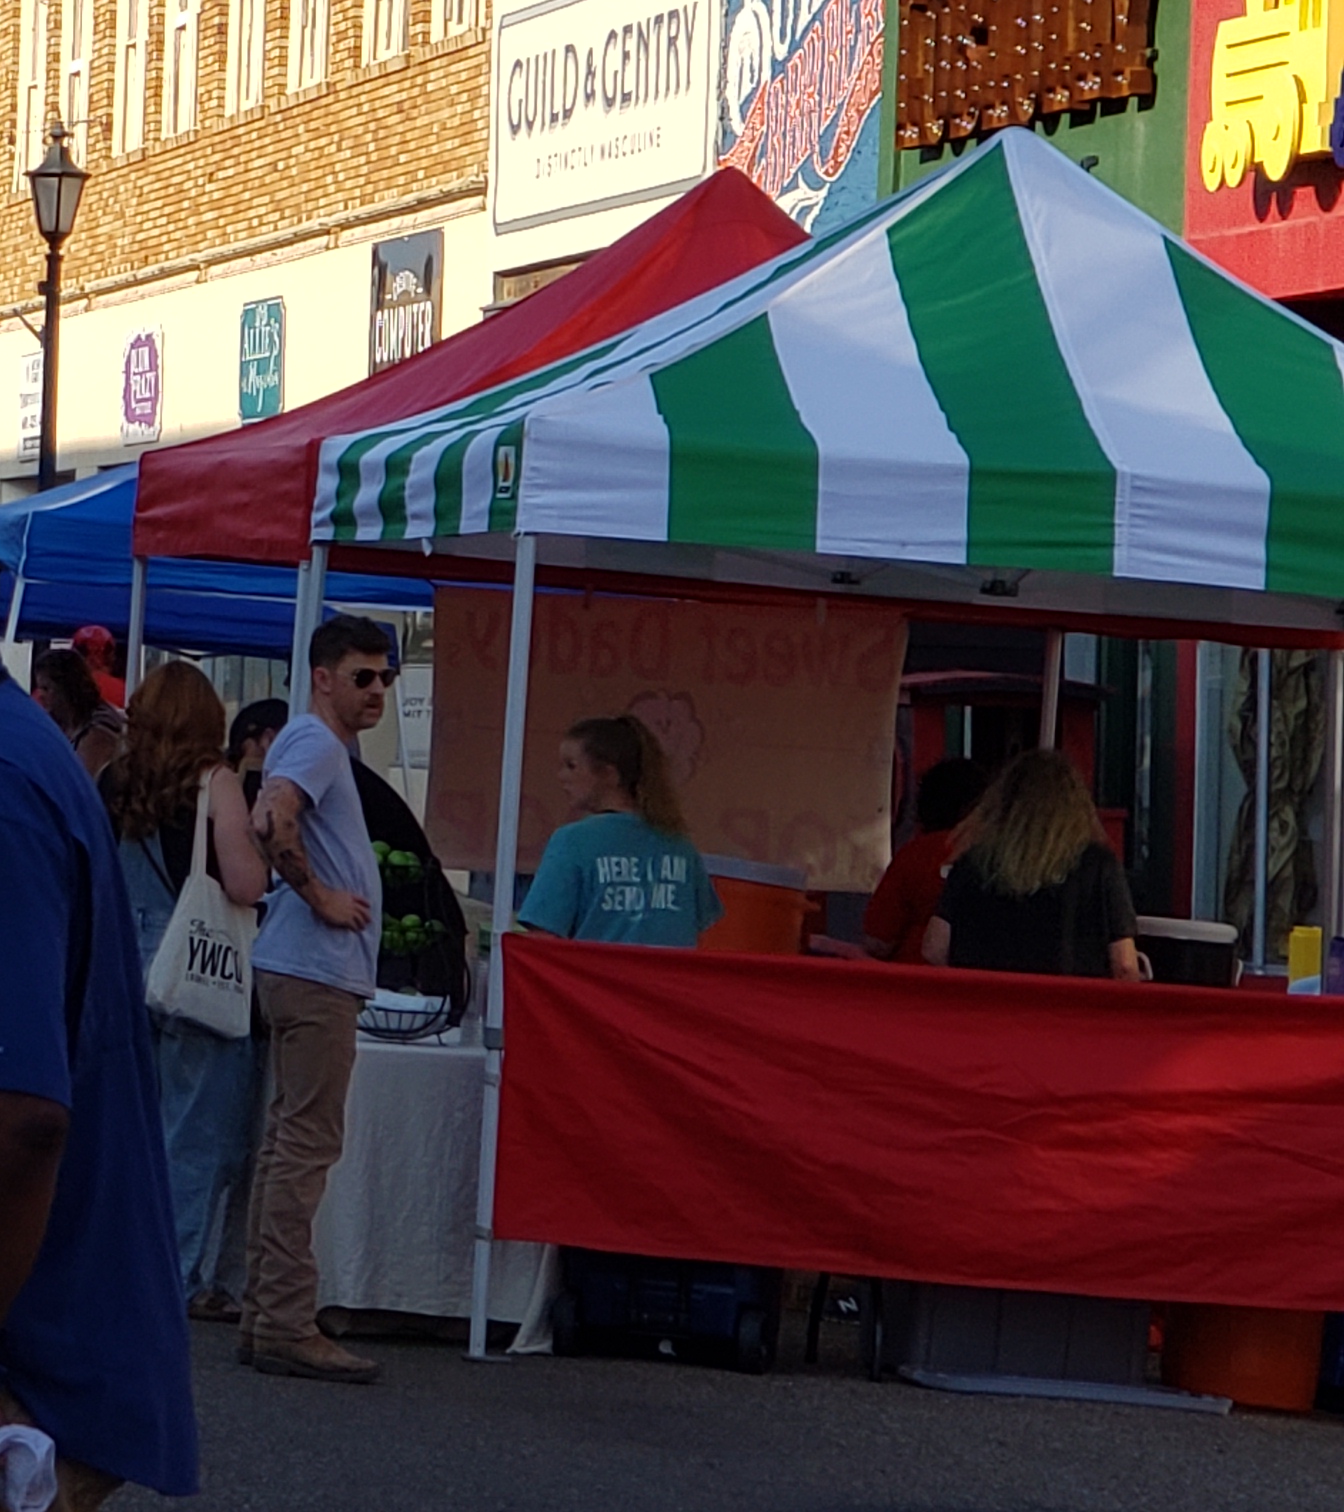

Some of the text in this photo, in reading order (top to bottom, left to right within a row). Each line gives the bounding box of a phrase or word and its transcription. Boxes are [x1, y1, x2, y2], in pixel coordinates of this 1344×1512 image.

[507, 1, 699, 139] GUILD & GENTRY
[535, 126, 663, 180] DISTINCTLY MASCULINE
[374, 300, 433, 364] COMPUTER
[596, 855, 642, 885] HERE
[660, 854, 687, 884] AM
[600, 883, 681, 912] SEND ME
